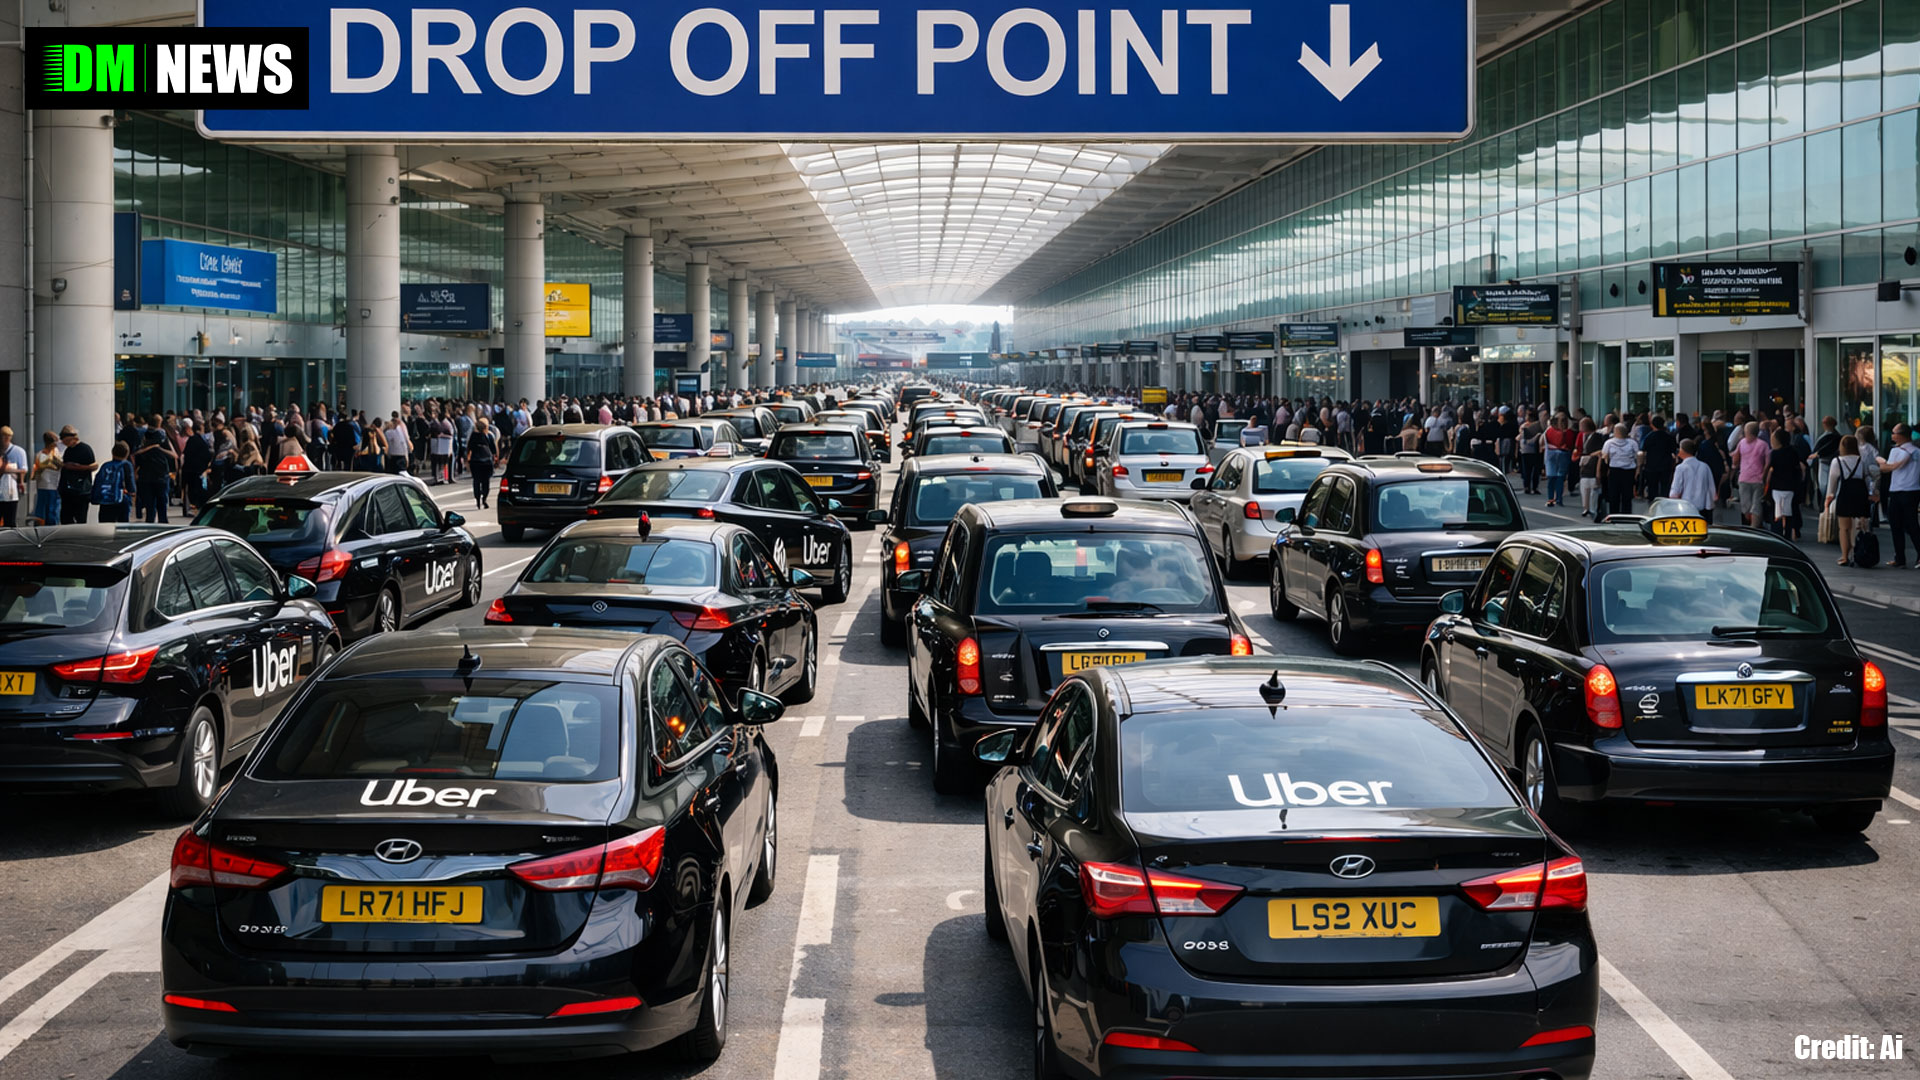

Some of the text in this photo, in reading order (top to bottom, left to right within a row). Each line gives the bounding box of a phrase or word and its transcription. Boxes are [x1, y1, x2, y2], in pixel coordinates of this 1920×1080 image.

[330, 7, 1251, 96] DROP OFF POINT
[1659, 520, 1697, 533] TAXI
[252, 641, 297, 697] Uber
[1705, 687, 1785, 705] LK71 GFY
[359, 778, 498, 808] Uber
[1227, 772, 1393, 807] Uber
[340, 890, 464, 916] LR71 HFJ
